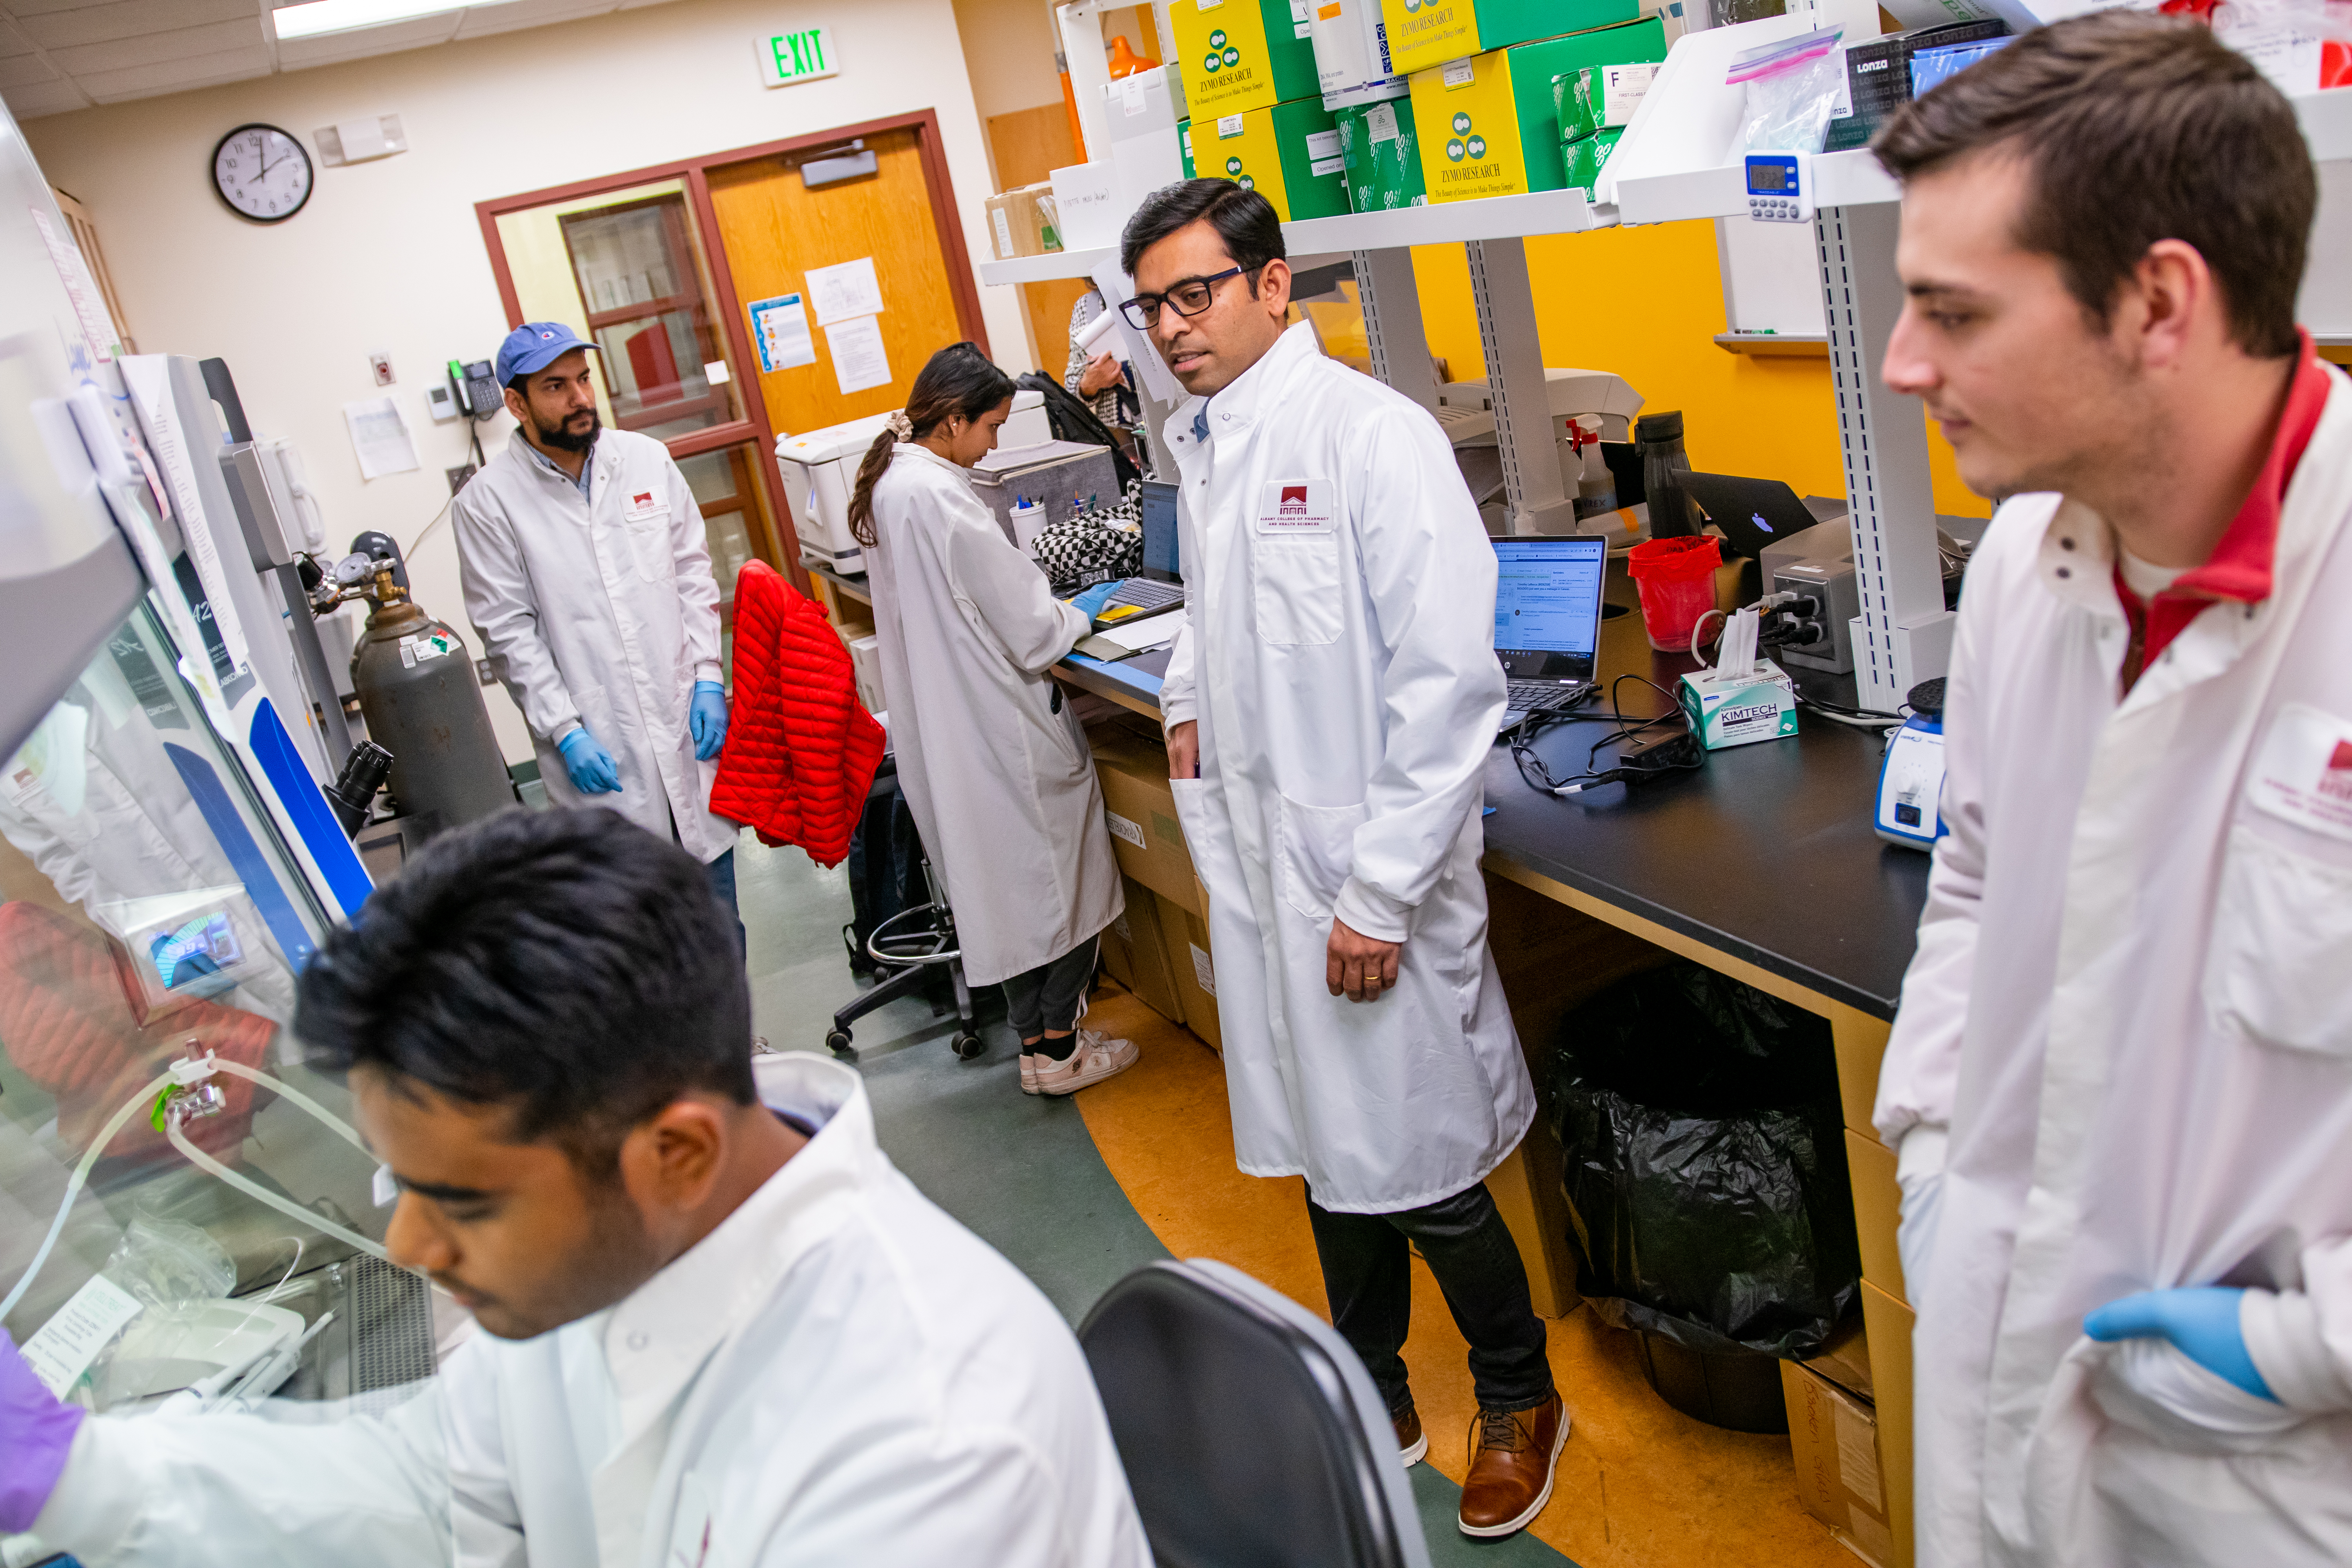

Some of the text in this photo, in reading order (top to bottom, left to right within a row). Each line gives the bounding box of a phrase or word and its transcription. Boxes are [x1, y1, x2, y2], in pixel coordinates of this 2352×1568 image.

[1401, 7, 1454, 37] ZYMO RESEARCH
[1401, 43, 1412, 53] Beauty
[1412, 41, 1416, 50] of
[1416, 38, 1427, 48] Science
[1434, 33, 1443, 42] Make
[1443, 29, 1454, 38] Things
[770, 29, 825, 78] EXIT
[1857, 59, 1888, 73] Lonza
[1200, 68, 1252, 92] ZYMO RESEARCH
[1611, 72, 1619, 87] F
[1200, 96, 1210, 104] Beauty
[1214, 91, 1225, 101] Science
[1232, 87, 1241, 96] Make
[248, 136, 261, 146] 12
[234, 143, 243, 154] 11
[226, 158, 237, 169] 10
[1317, 164, 1335, 172] Opened
[226, 174, 234, 184] 9
[1441, 163, 1501, 183] ZYMO RESEARCH
[292, 178, 299, 188] 4
[1442, 189, 1453, 198] Beauty
[1453, 188, 1457, 198] of
[1457, 187, 1470, 196] Science
[1488, 184, 1501, 193] Things
[1584, 499, 1606, 508] VIREX
[1787, 681, 1791, 690] 1
[1721, 703, 1777, 722] KIMTECH
